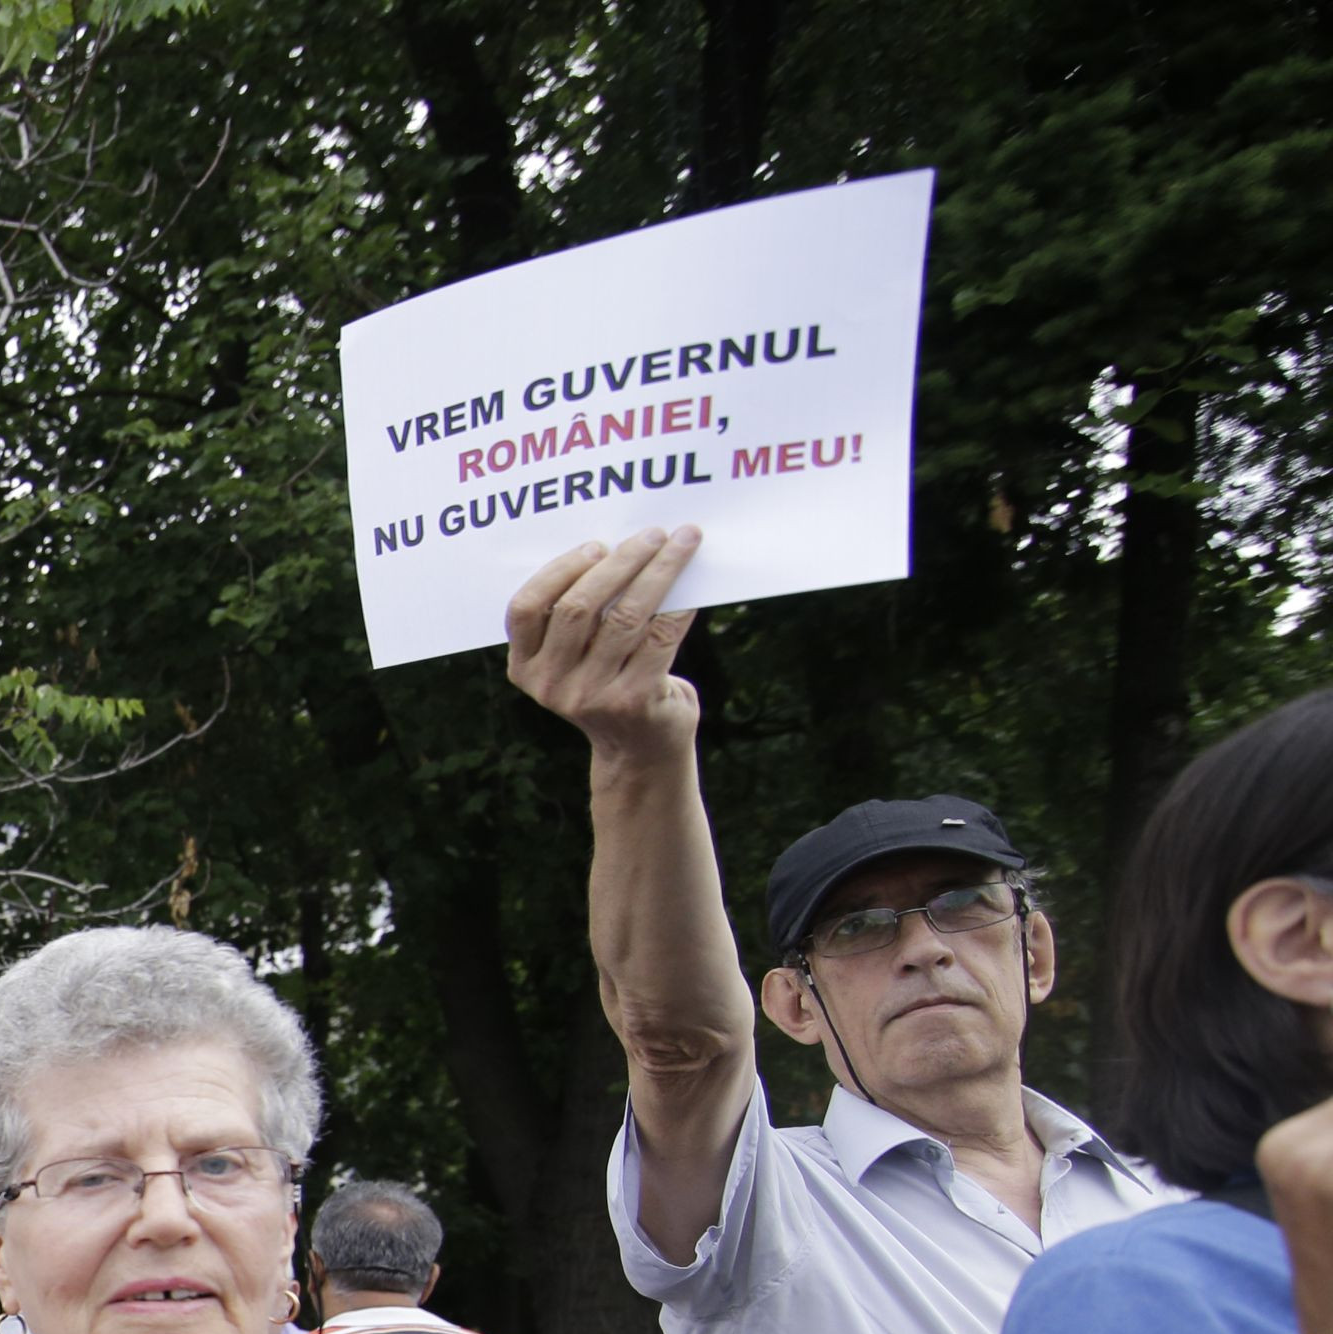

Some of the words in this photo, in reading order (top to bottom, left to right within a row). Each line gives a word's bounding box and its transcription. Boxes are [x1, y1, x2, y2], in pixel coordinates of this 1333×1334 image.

[386, 390, 505, 453] VREM
[522, 324, 836, 412] GUVERNUL
[458, 395, 729, 483] ROMÂNIEI,
[373, 515, 424, 556] NU
[438, 452, 712, 539] GUVERNUL
[731, 434, 864, 479] MEU!
